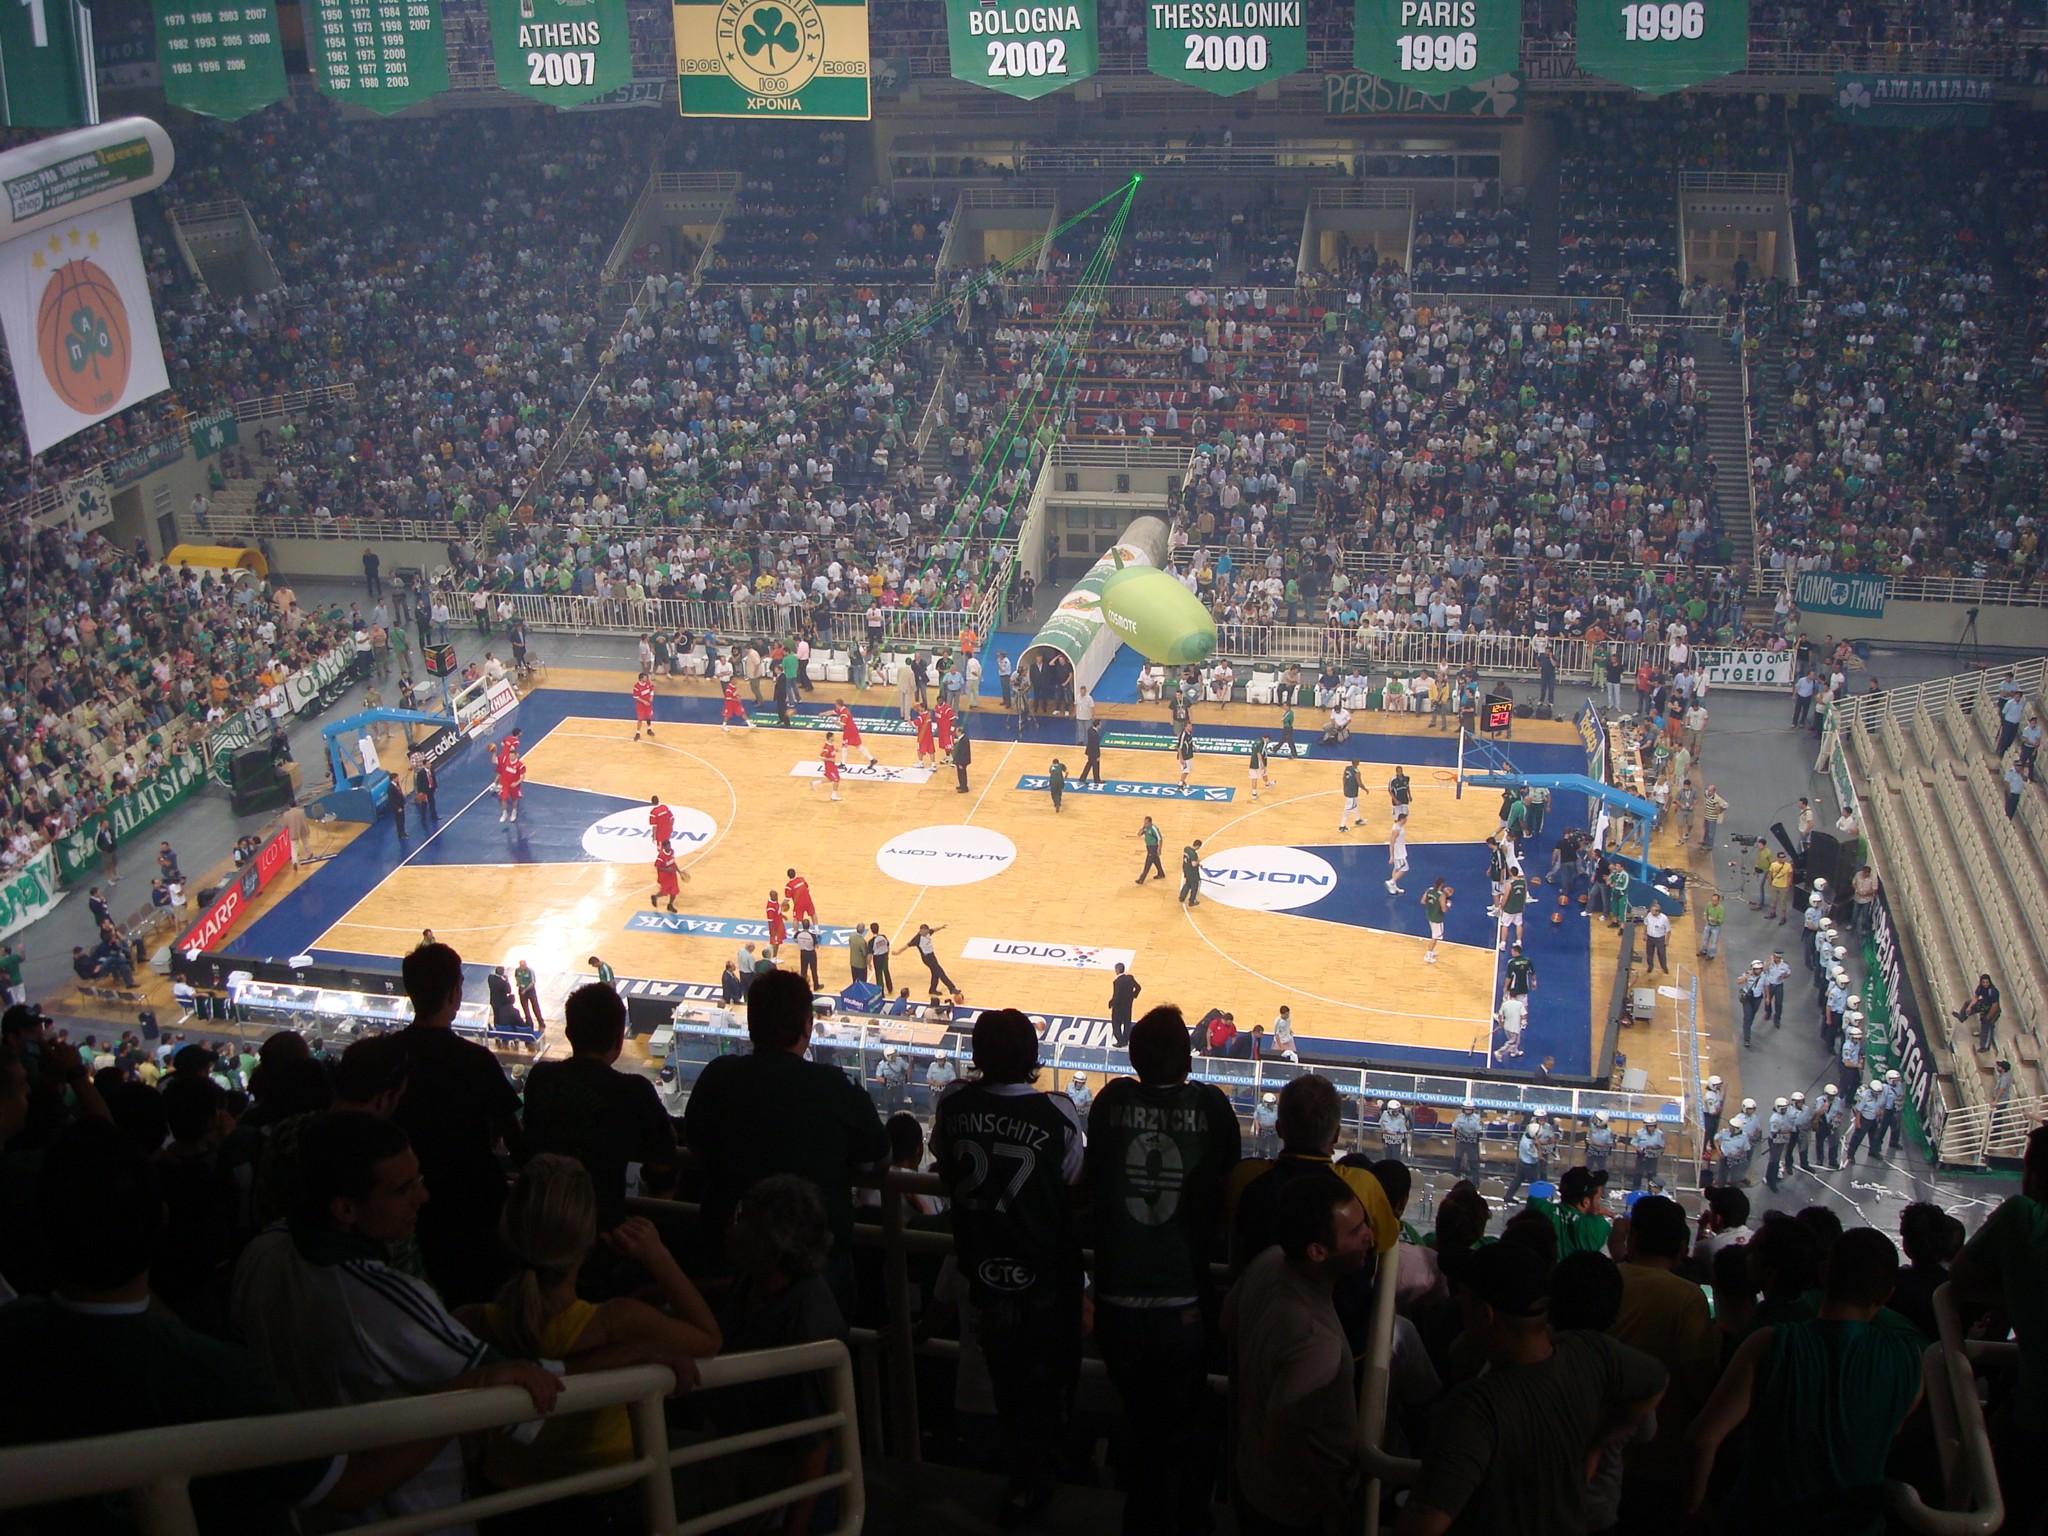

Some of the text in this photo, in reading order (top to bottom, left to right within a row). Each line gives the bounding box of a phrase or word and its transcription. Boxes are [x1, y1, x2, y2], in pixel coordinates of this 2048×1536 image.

[245, 8, 266, 20] 2007
[322, 6, 430, 20] 1950 1972 1984 2006
[1151, 1, 1301, 29] THESSALONIKI
[1401, 1, 1476, 27] PARIS
[323, 20, 430, 34] 1951 1973 1998 2007
[969, 6, 1081, 36] BOLOGNA
[1621, 2, 1705, 42] 1996
[248, 33, 270, 44] 2008
[325, 35, 404, 48] 1954 1974 1999
[519, 21, 600, 48] ATHENS
[326, 49, 406, 62] 1961 1975 2000
[987, 38, 1067, 77] 2002
[1185, 34, 1268, 72] 2000
[1397, 32, 1477, 71] 1996
[328, 62, 407, 76] 1962 1977 2001
[528, 52, 595, 86] 2007
[680, 59, 720, 72] 1908
[823, 61, 866, 74] 2008
[330, 76, 409, 90] 1967 1980 2003
[759, 78, 788, 92] 100
[747, 97, 801, 111] ΧΡΟΝΙΑ
[1709, 669, 1775, 681] ΓΥΘΕΙΟ
[1491, 704, 1513, 713] 12:47
[1490, 712, 1509, 727] 24
[262, 843, 278, 871] LCD
[884, 848, 1009, 862] ALPHA COPY
[1203, 867, 1329, 886] NOKIA
[631, 915, 727, 934] BANK
[676, 1024, 718, 1034] POWERADE
[816, 1038, 859, 1048] POWERADE
[1060, 1061, 1104, 1071] POWERADE
[1366, 1089, 1413, 1099] POWERADE
[1417, 1093, 1465, 1103] POWERADE
[1472, 1098, 1520, 1109] POWERADE
[1109, 1105, 1210, 1133] WARZYCHA
[953, 1139, 1036, 1213] 27
